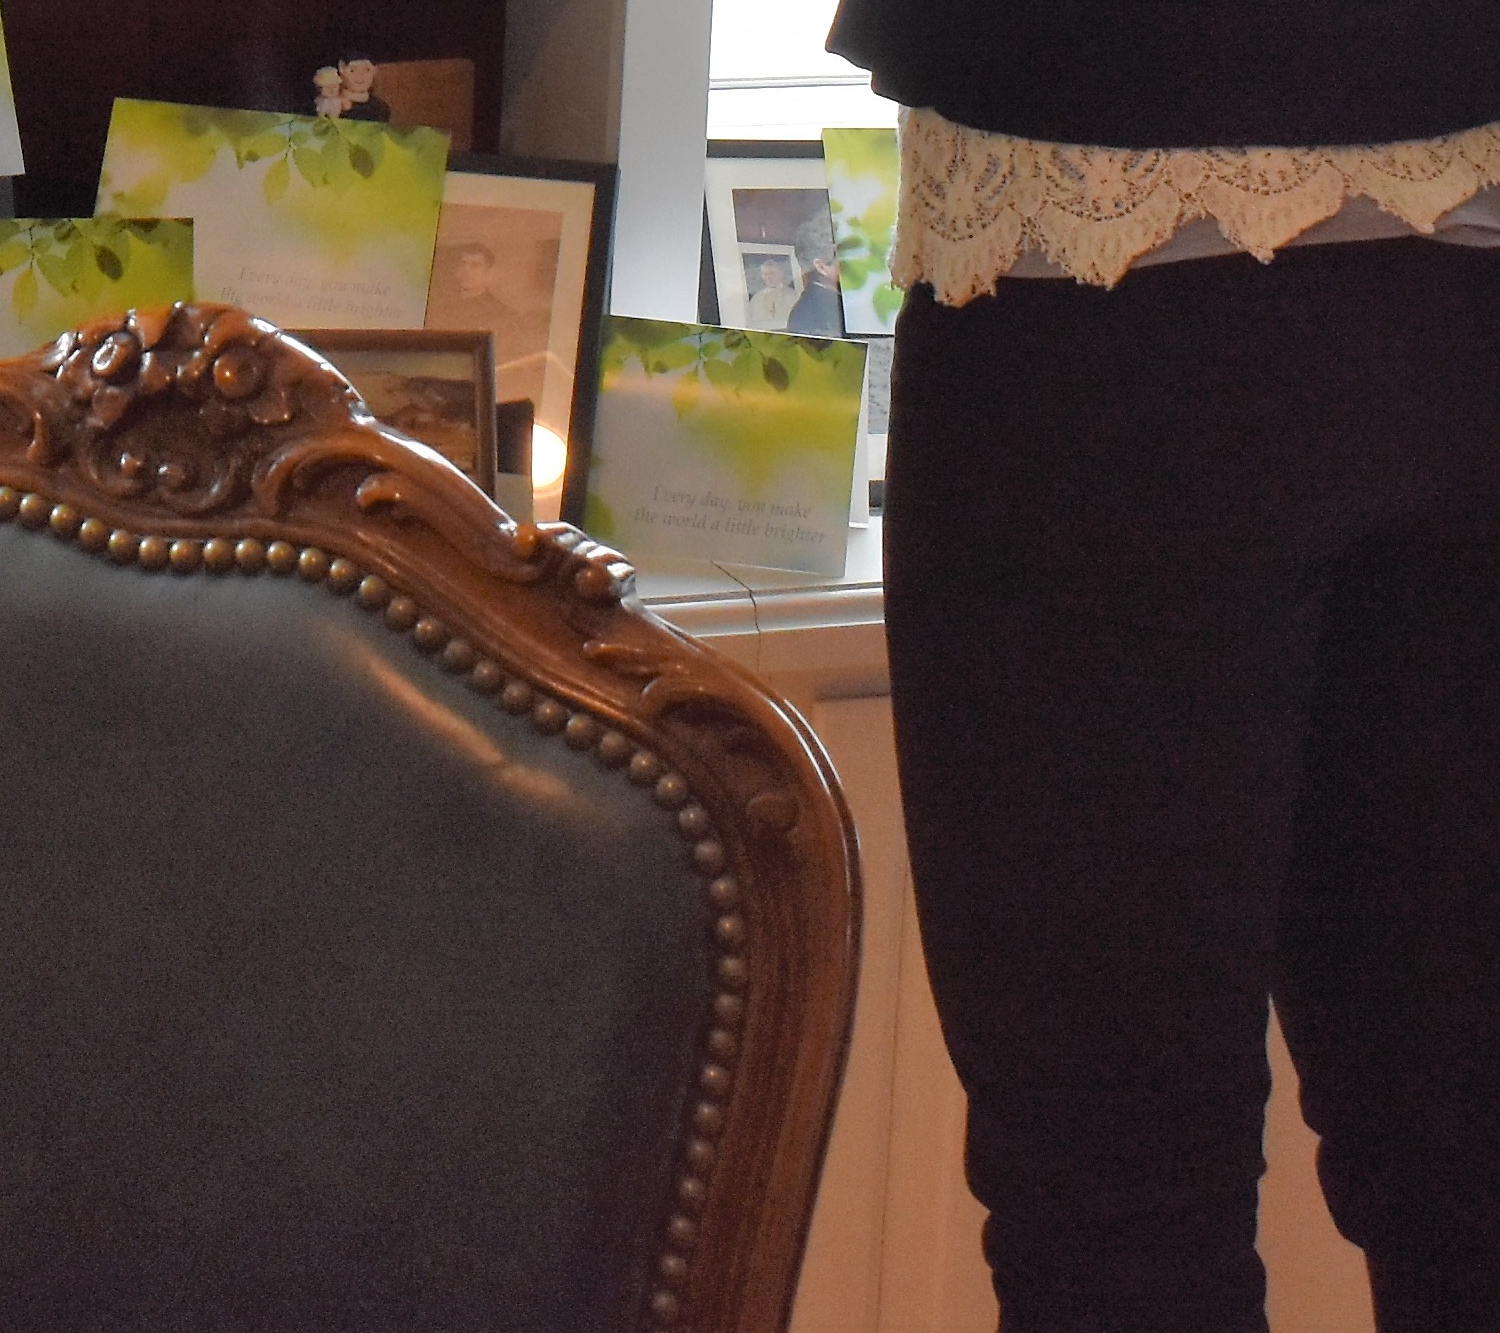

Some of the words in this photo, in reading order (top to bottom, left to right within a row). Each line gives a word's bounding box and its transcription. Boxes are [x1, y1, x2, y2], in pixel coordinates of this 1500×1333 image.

[651, 485, 697, 510] Every
[736, 500, 765, 518] you
[770, 498, 812, 519] make
[633, 506, 659, 524] the
[662, 510, 706, 530] world
[723, 517, 757, 536] little
[762, 522, 826, 549] brighter
